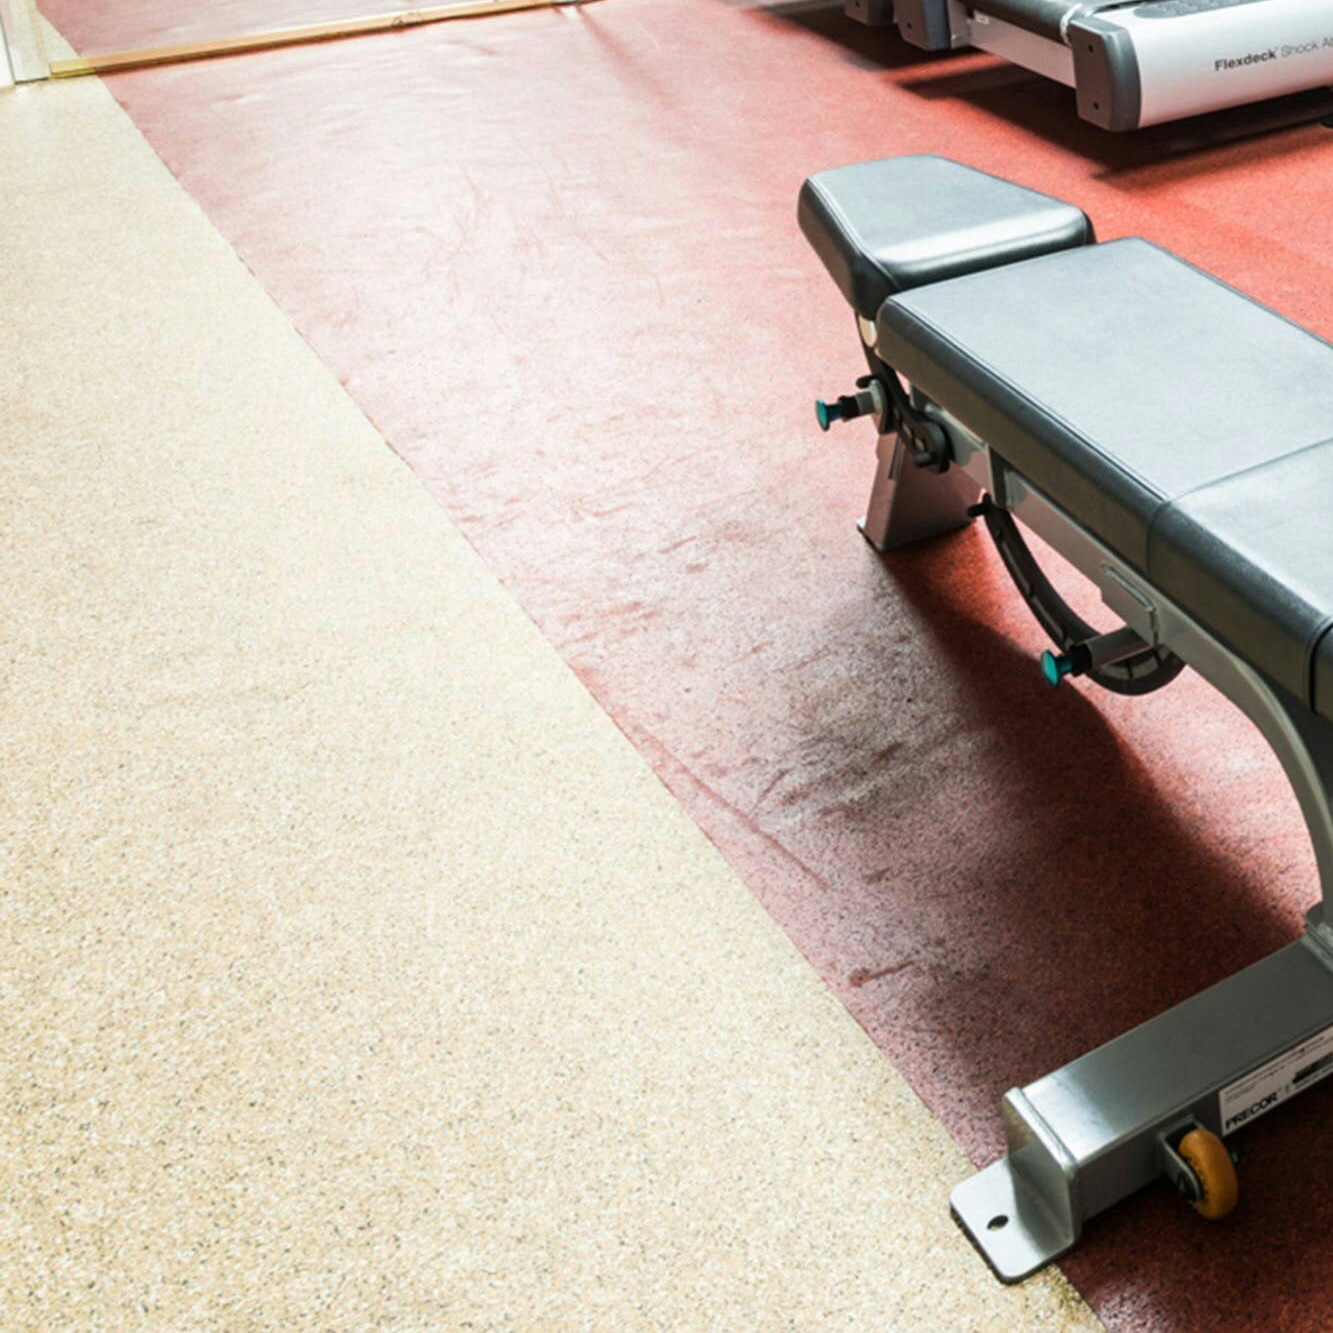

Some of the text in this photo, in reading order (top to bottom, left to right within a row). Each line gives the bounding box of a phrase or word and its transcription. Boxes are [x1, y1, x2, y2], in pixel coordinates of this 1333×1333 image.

[1214, 48, 1277, 72] Flexdeck
[1281, 40, 1319, 58] Shock
[1226, 1093, 1278, 1131] PRECOR
